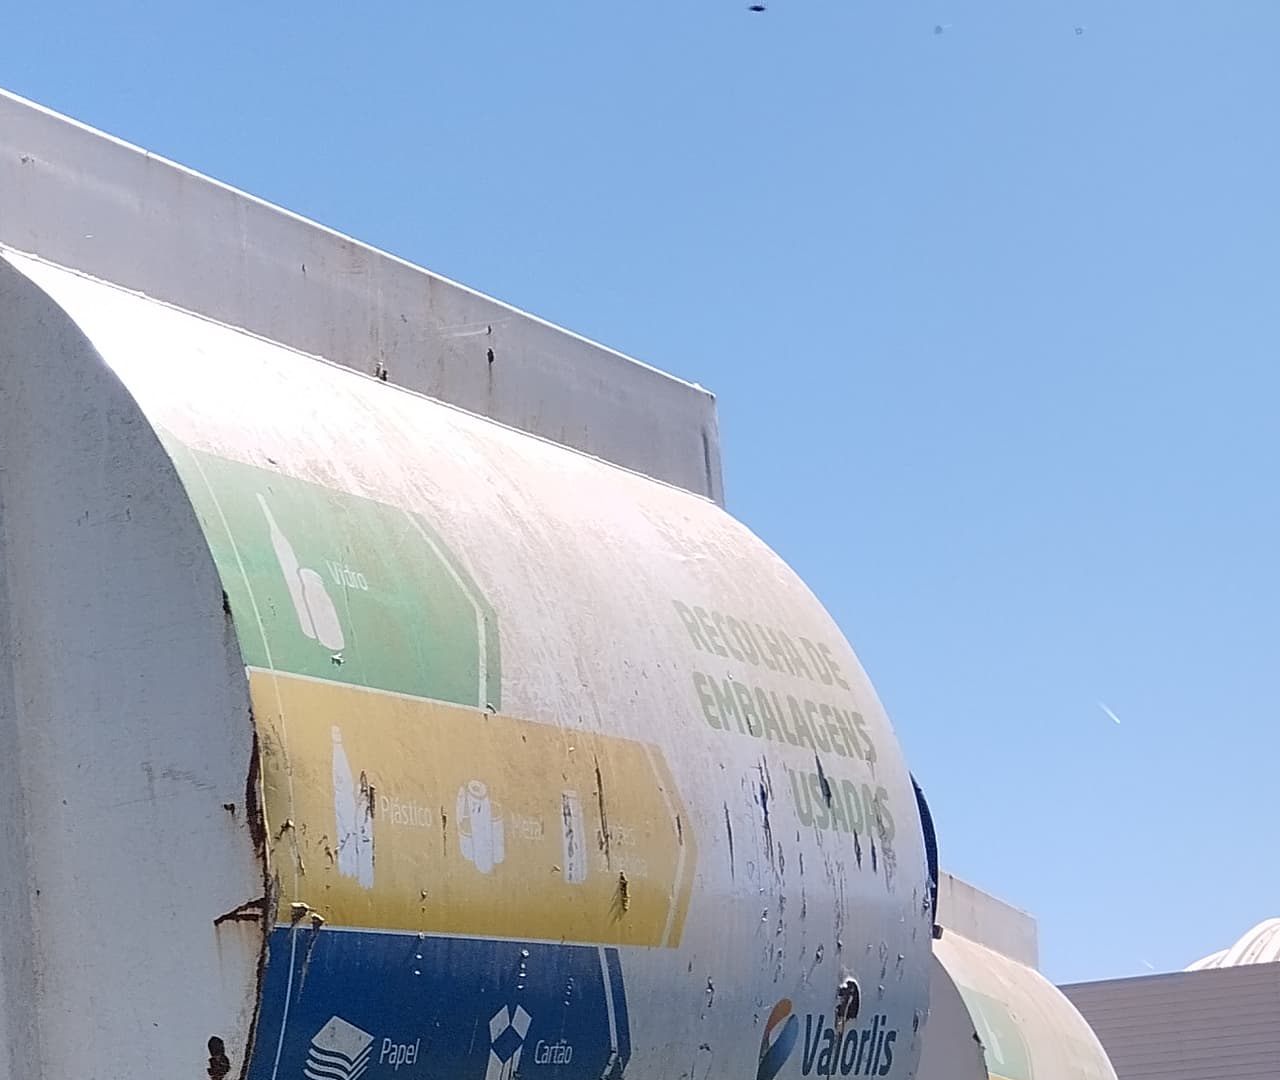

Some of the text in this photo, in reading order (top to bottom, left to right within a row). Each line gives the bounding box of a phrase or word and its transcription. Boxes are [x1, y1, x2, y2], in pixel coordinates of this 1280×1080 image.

[326, 558, 368, 591] Vidro
[671, 599, 850, 690] RECOLHA DE
[692, 671, 877, 764] EMBALAGENS
[380, 794, 433, 828] Plástico
[788, 767, 896, 841] USADAS
[378, 1037, 421, 1071] Papel
[533, 1039, 573, 1065] Cartão
[801, 1014, 897, 1077] Valorlis
